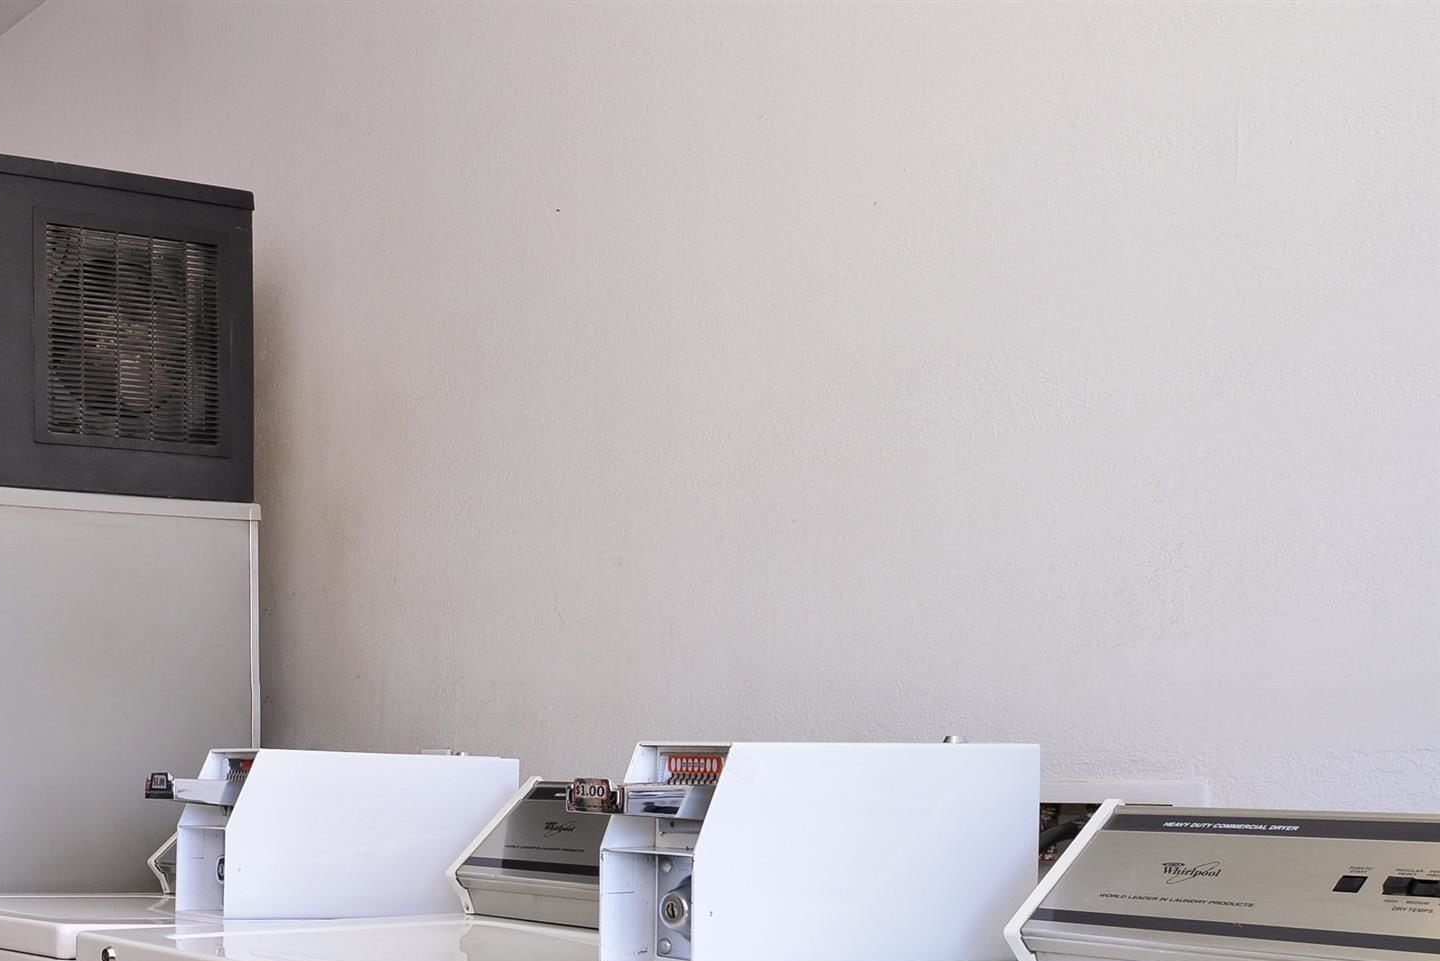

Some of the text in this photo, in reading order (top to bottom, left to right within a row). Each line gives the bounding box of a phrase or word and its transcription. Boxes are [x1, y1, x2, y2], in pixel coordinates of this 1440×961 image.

[575, 785, 605, 797] $1.00
[1163, 866, 1222, 878] Whirlpool
[1208, 900, 1255, 908] PRODUCTS
